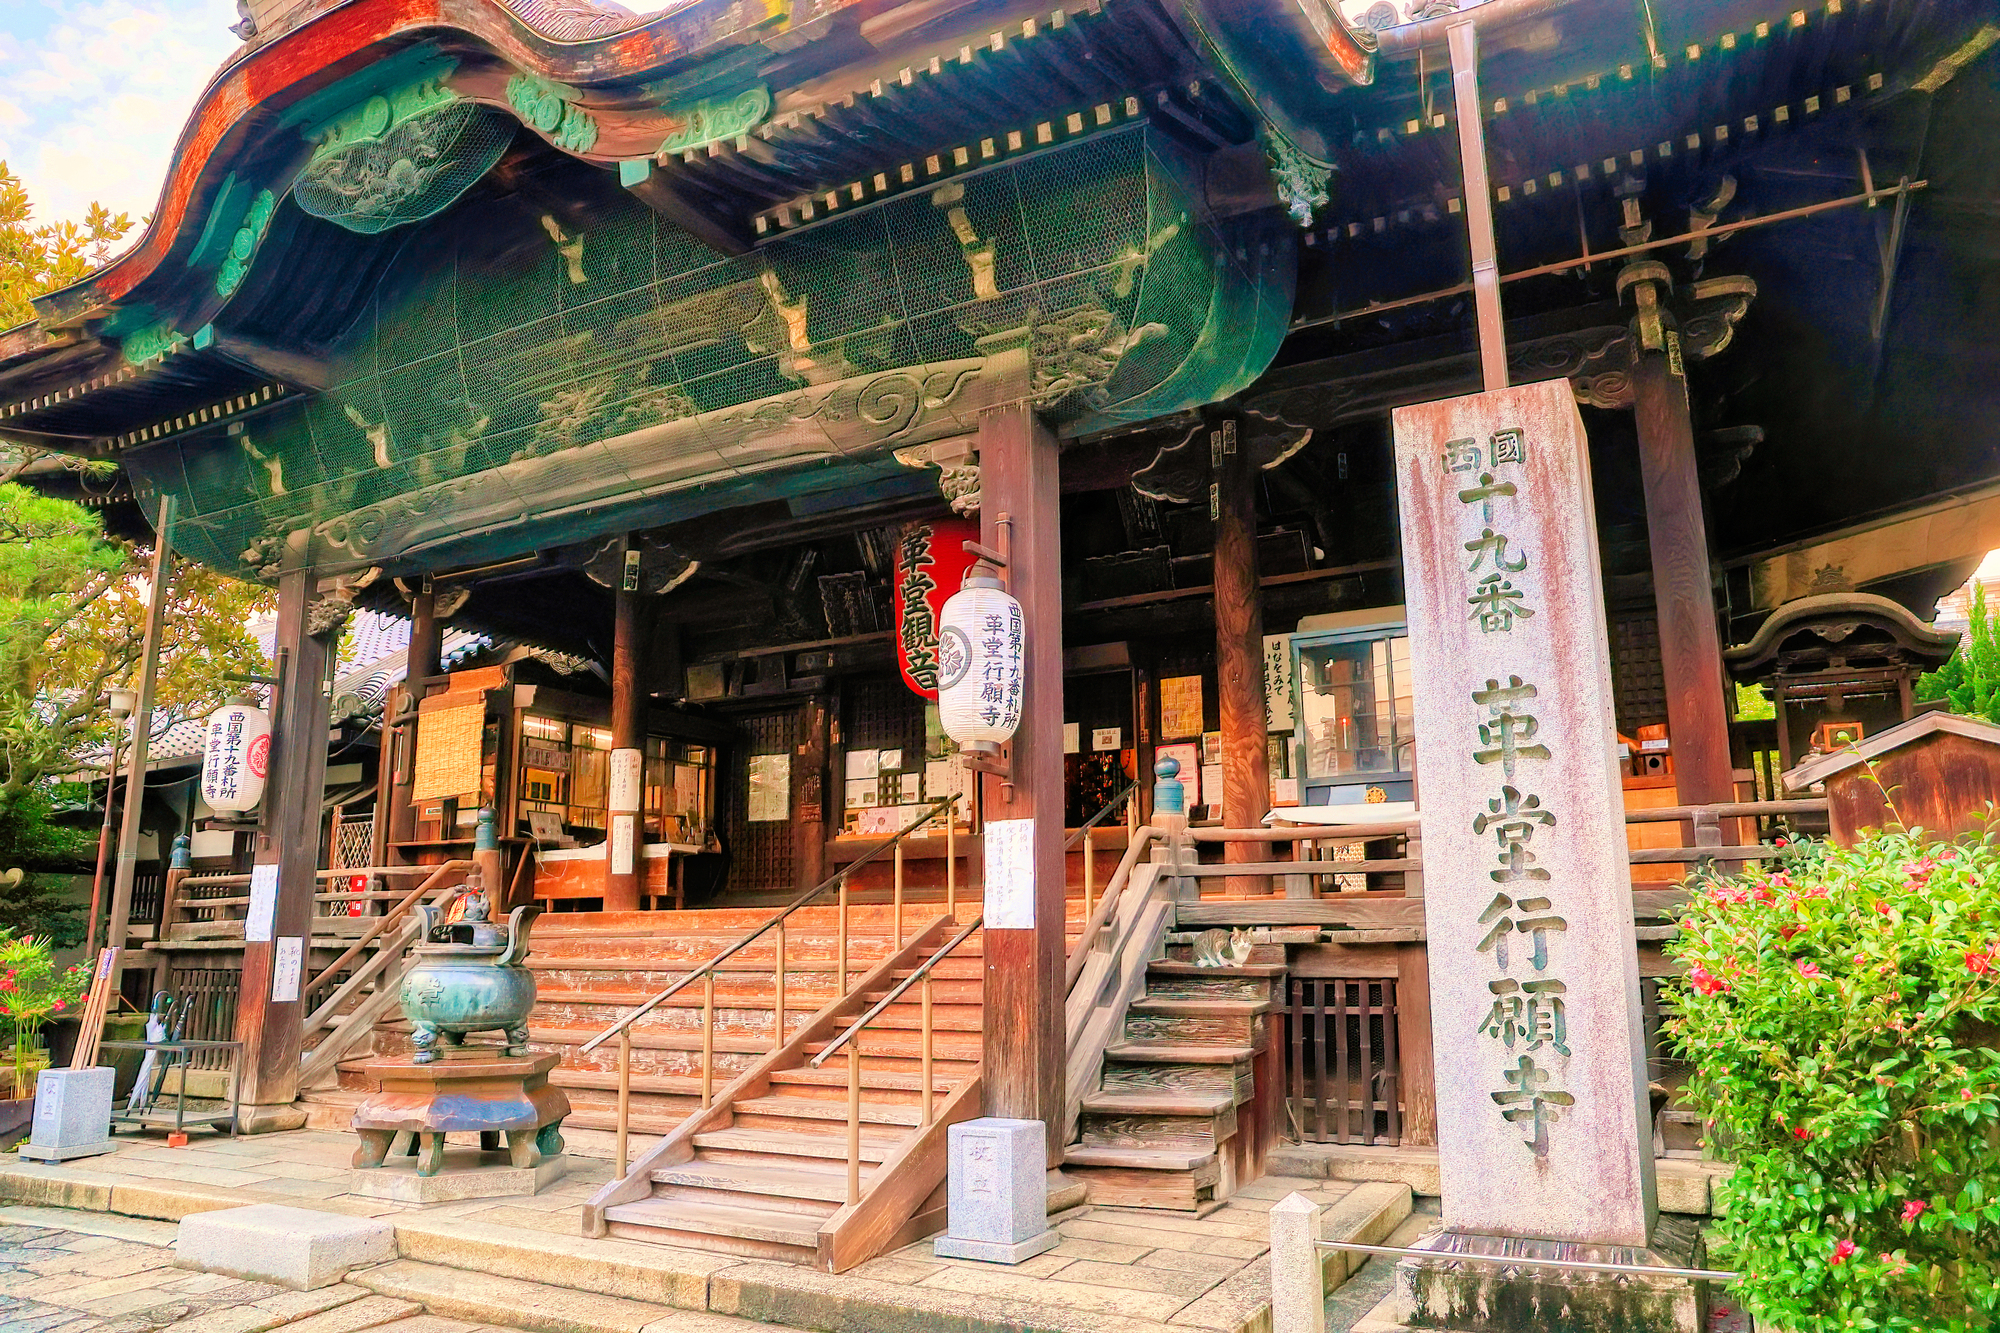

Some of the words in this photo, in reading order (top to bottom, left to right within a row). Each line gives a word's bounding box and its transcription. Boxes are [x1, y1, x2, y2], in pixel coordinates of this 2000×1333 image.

[898, 524, 939, 690] 革堂観音
[979, 613, 1005, 728] 革堂行願寺
[1000, 601, 1023, 730] 西国第十九番札所
[1271, 640, 1284, 696] はなをみて
[205, 722, 223, 799] 革堂行願寺
[219, 711, 246, 800] 西国第十九番札所
